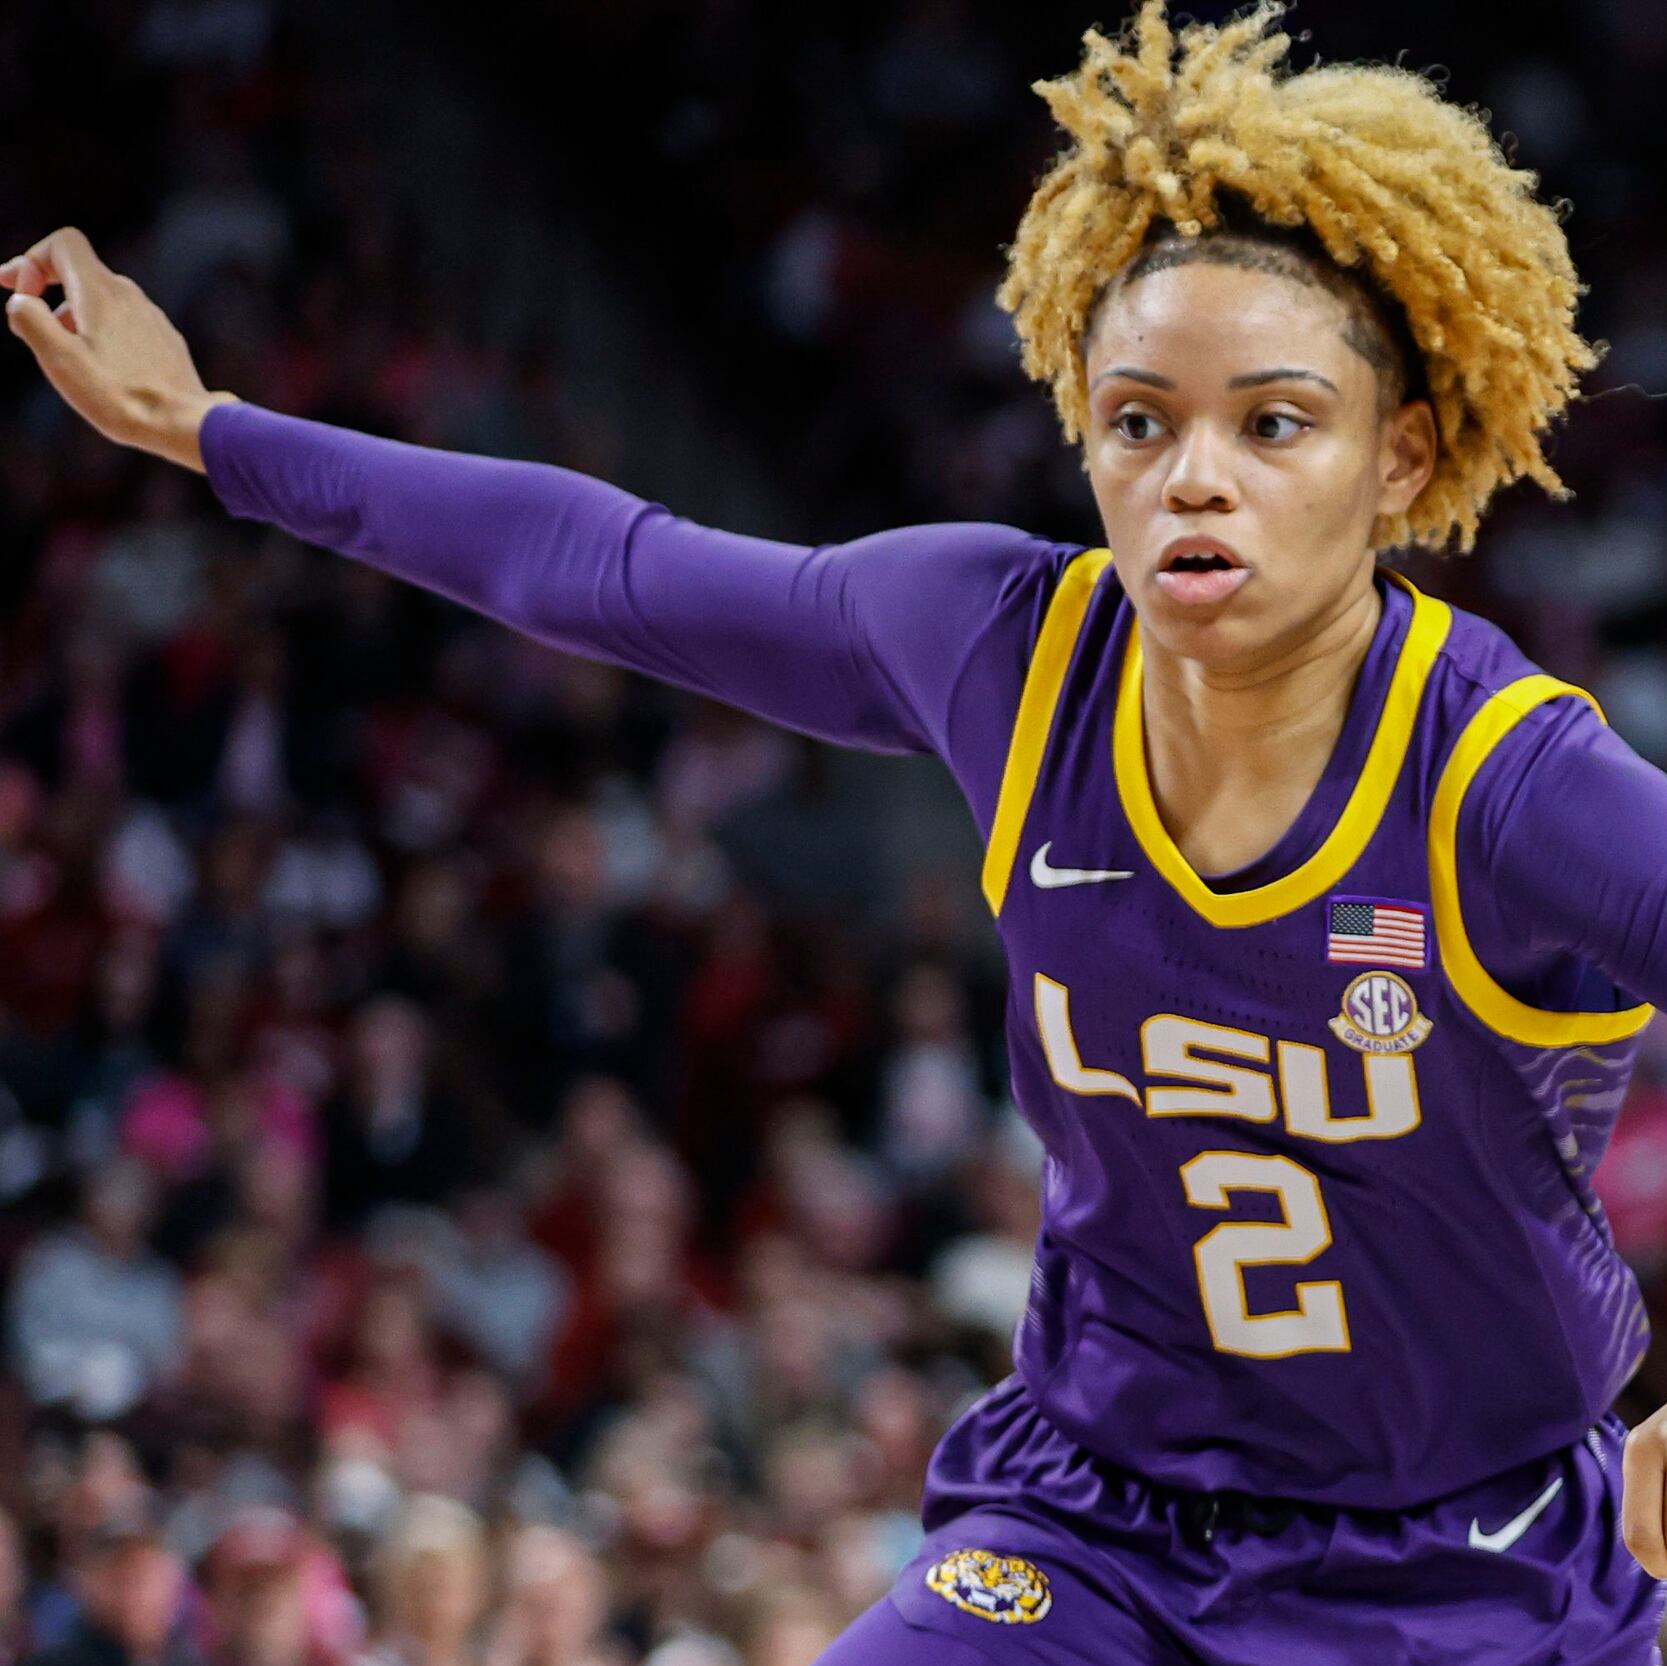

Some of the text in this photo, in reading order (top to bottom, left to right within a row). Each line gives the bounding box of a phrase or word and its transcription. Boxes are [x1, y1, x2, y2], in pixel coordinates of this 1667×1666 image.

[1034, 973, 1422, 1143] LSU
[1343, 1027, 1419, 1052] GRADUATE
[1348, 976, 1411, 1036] SEC
[1179, 1150, 1351, 1360] 2
